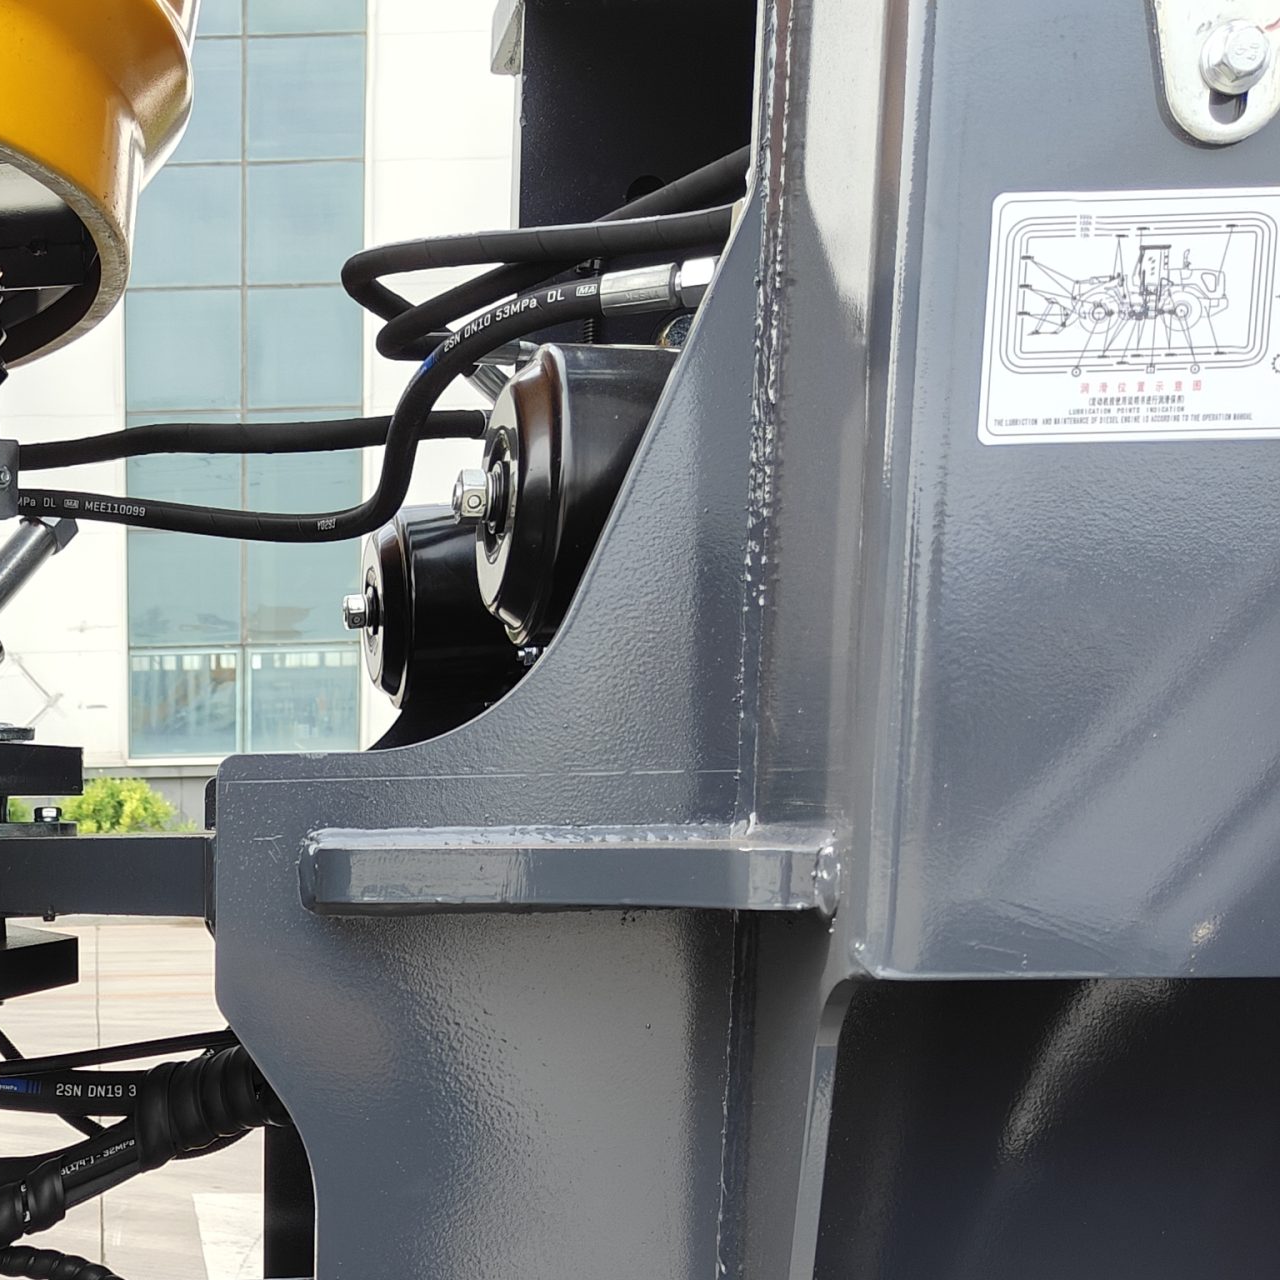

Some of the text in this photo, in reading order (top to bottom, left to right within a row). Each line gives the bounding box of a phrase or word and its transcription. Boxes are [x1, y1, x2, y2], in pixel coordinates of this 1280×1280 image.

[443, 332, 461, 352] 2SN
[464, 314, 491, 338] DN10
[495, 298, 538, 321] 53MPa
[547, 290, 565, 303] DL
[43, 497, 56, 508] DL
[84, 500, 146, 517] MEE110099
[56, 1083, 82, 1097] 2SN
[88, 1084, 123, 1098] DN19
